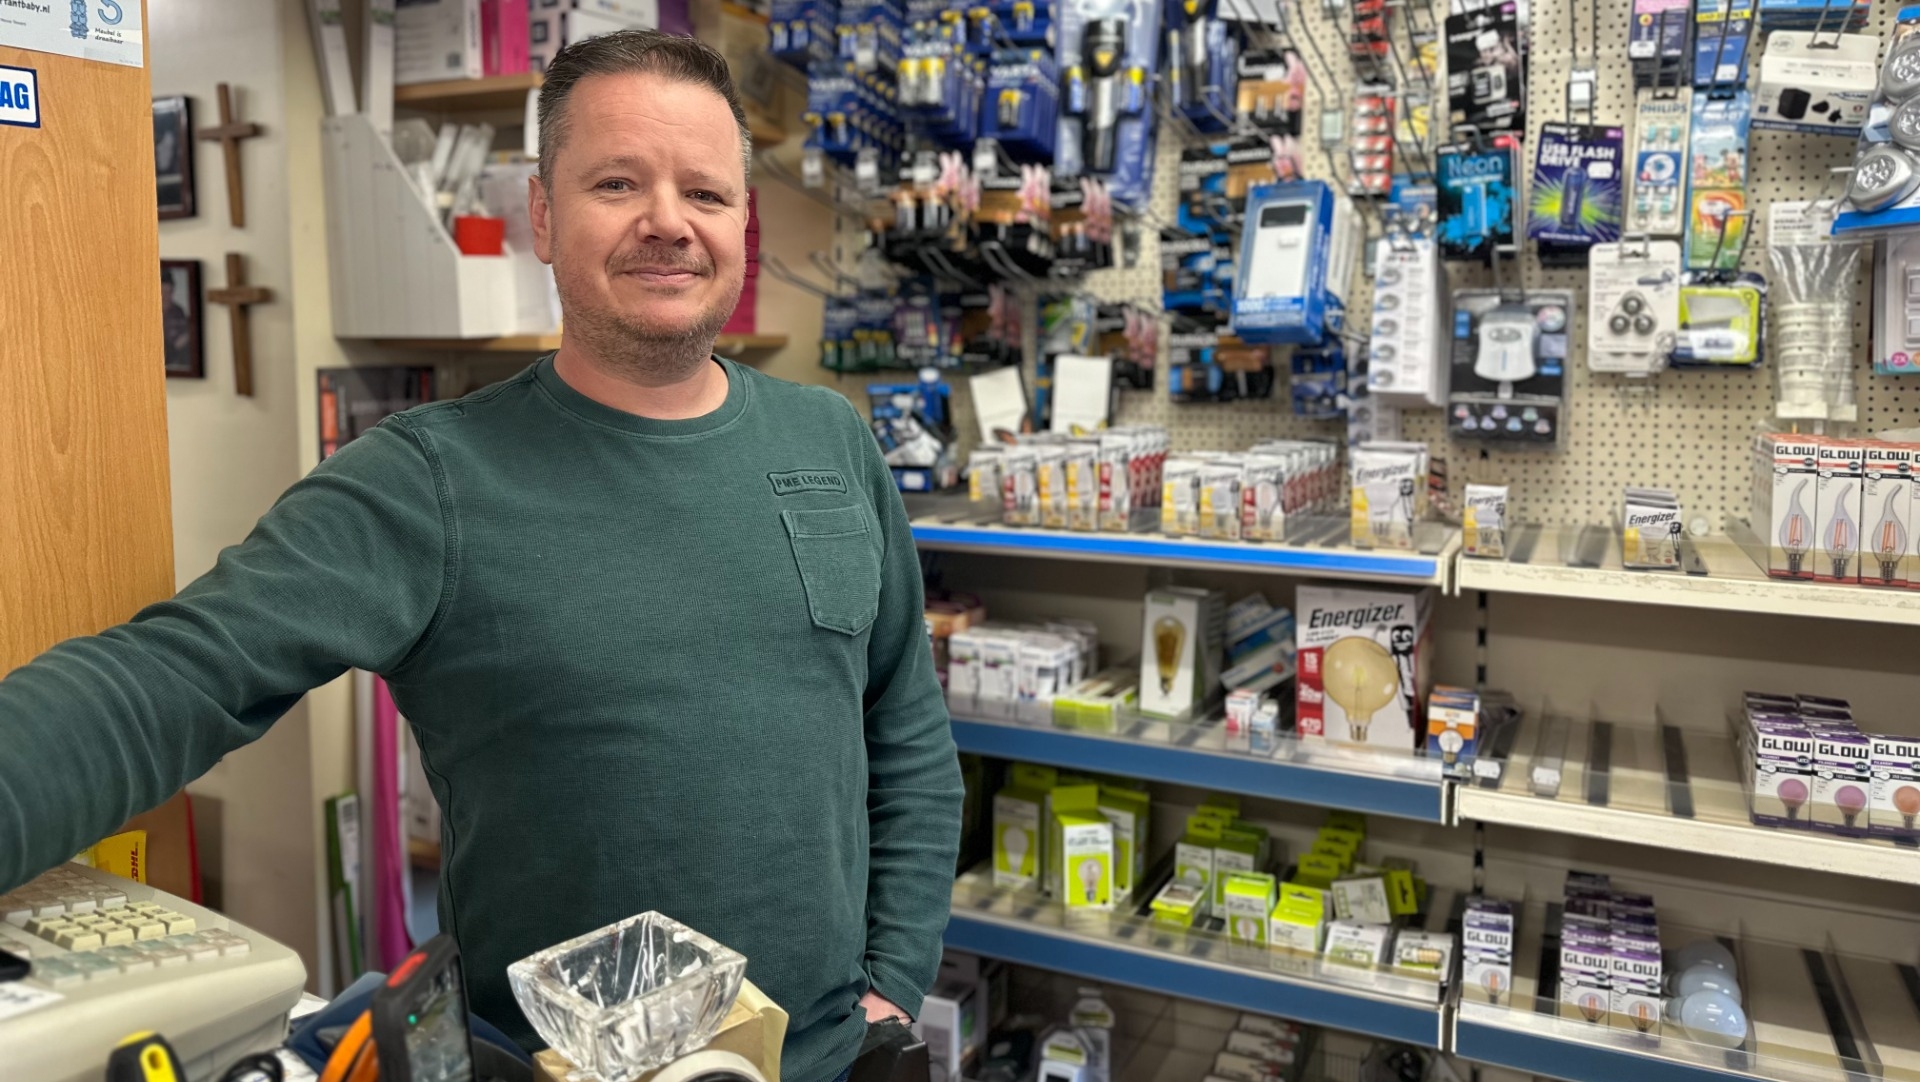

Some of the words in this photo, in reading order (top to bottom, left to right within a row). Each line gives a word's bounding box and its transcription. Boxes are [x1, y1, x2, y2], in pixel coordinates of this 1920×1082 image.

[1640, 103, 1687, 114] PHILIPS
[1541, 143, 1569, 156] USB
[1572, 145, 1616, 160] FLASH
[1448, 156, 1503, 177] Neon
[1539, 154, 1581, 167] DRIVE
[1775, 445, 1815, 456] GLOW
[1820, 449, 1861, 460] GLOW
[1868, 450, 1910, 461] GLOW
[1356, 463, 1411, 481] Energizer
[775, 477, 801, 489] PME
[801, 475, 841, 486] LEGEND
[1468, 494, 1504, 506] Energizer
[1629, 511, 1677, 525] Energizer
[1308, 603, 1404, 630] Energizer
[1762, 737, 1811, 753] GLOW
[1818, 743, 1869, 760] GLOW
[1466, 930, 1509, 946] GLOW
[1564, 952, 1608, 970] GLOW
[1613, 960, 1659, 977] GLOW
